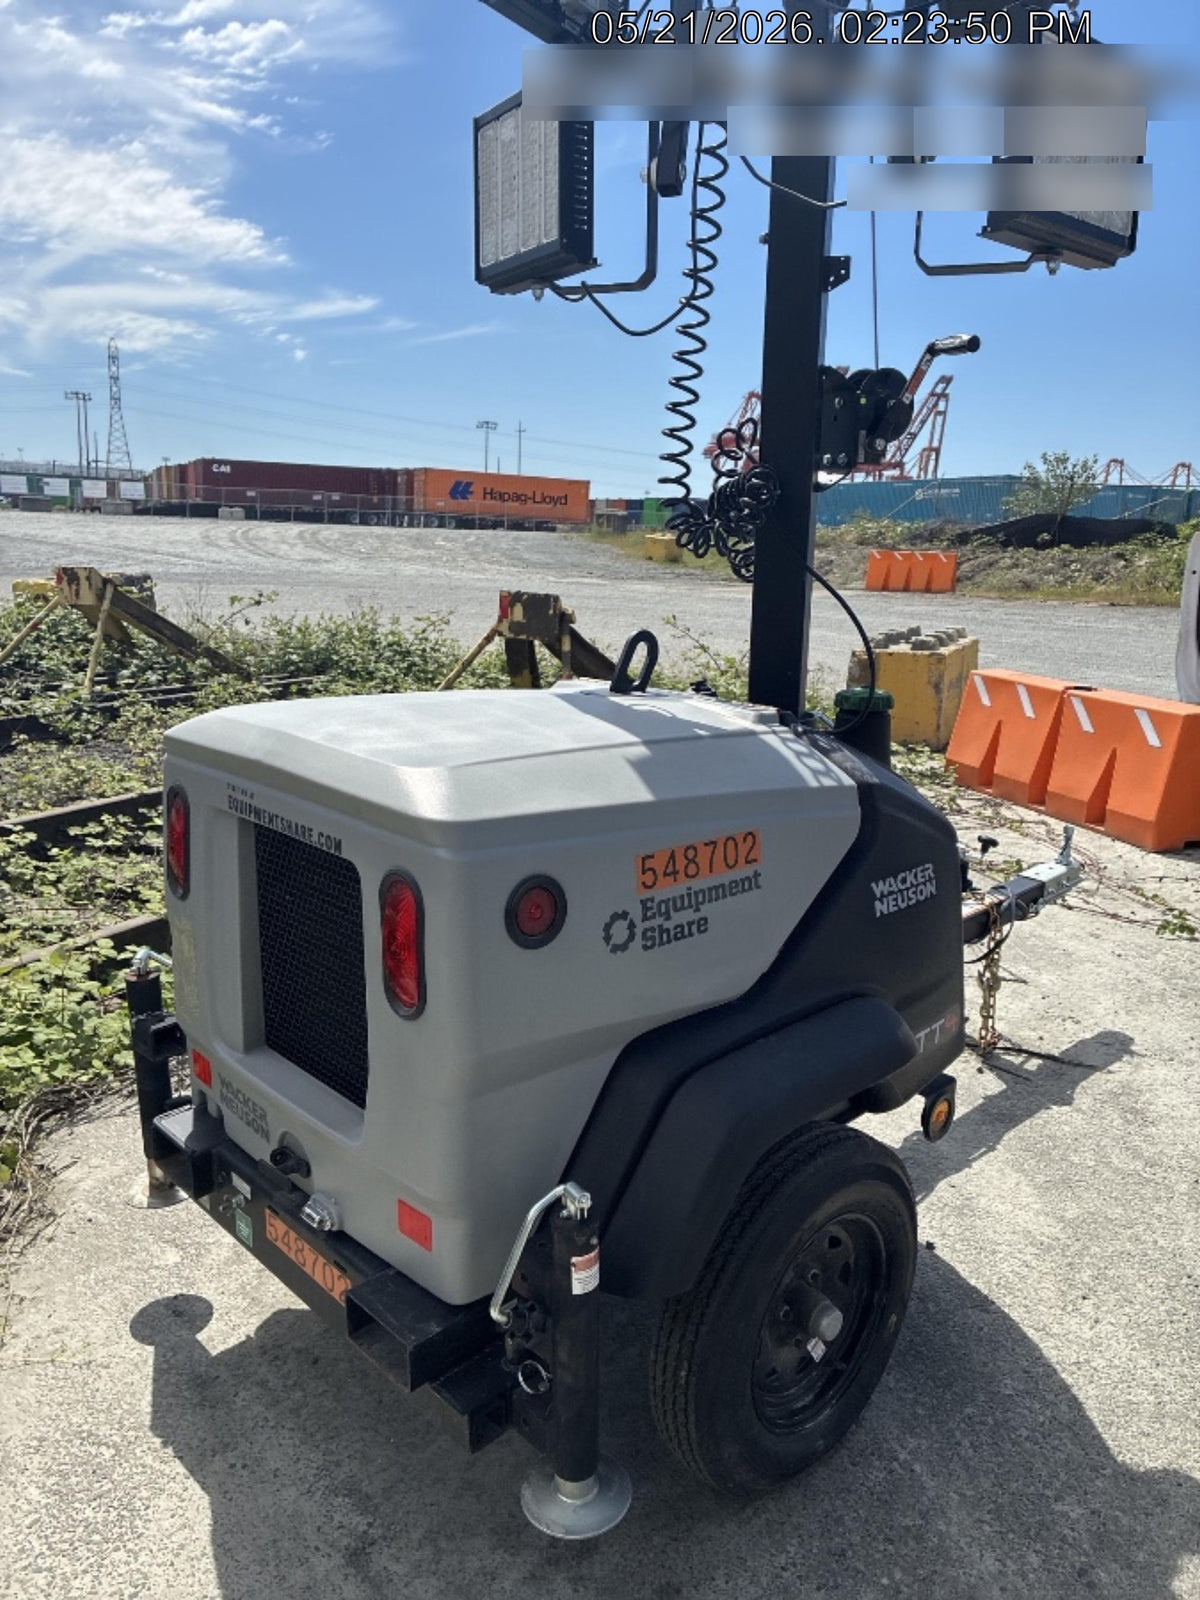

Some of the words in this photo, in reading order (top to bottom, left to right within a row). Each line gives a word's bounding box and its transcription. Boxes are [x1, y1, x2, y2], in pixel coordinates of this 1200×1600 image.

[482, 487, 568, 506] Hapag-Lloyd
[228, 794, 343, 855] EQUIPMENTSHARE.COM
[640, 831, 758, 890] 548702
[870, 863, 935, 898] WACKER
[639, 869, 762, 923] Equipment
[874, 879, 937, 918] NEUSON
[640, 916, 709, 951] Share
[218, 1072, 267, 1121] WACKER
[220, 1089, 270, 1145] NEUSON
